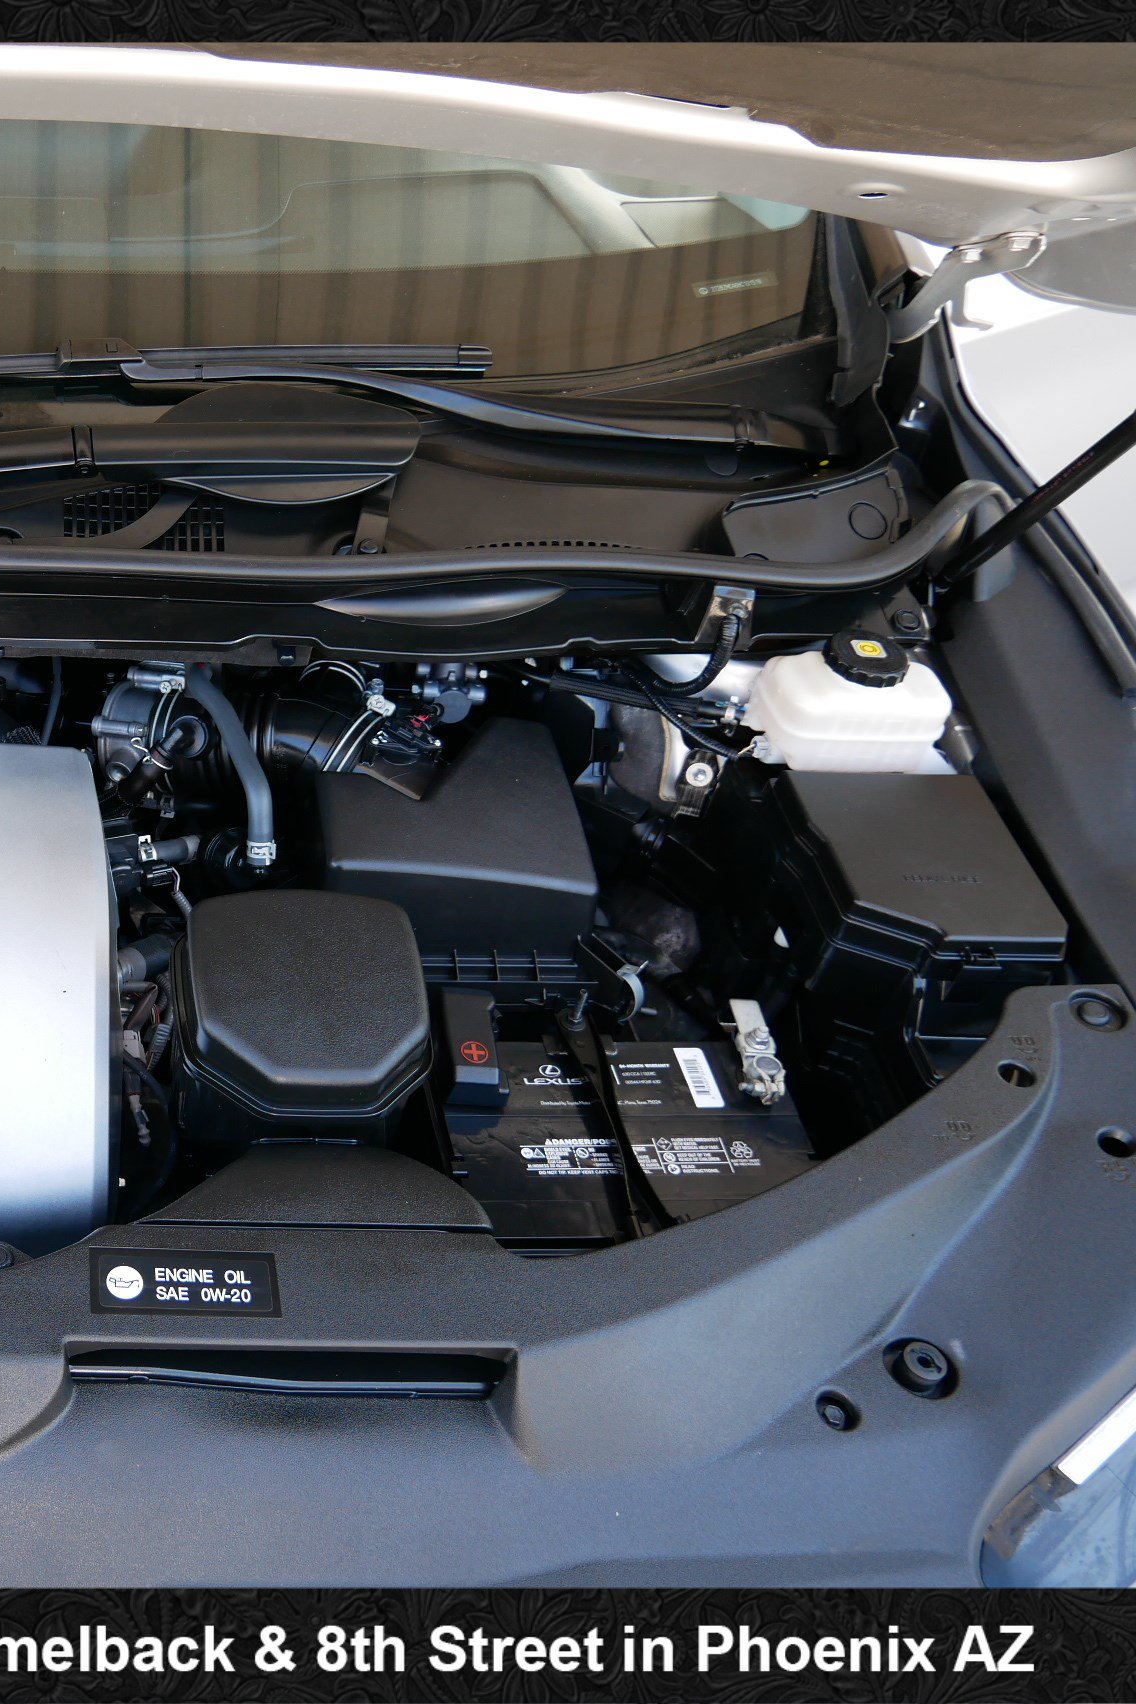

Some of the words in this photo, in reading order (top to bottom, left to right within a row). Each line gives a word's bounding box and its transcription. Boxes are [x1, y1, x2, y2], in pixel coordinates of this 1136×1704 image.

[523, 1077, 583, 1085] LEXUS
[154, 1267, 214, 1284] ENGINE
[224, 1270, 252, 1285] OIL
[155, 1286, 190, 1301] SAE
[200, 1287, 252, 1303] 0W-20
